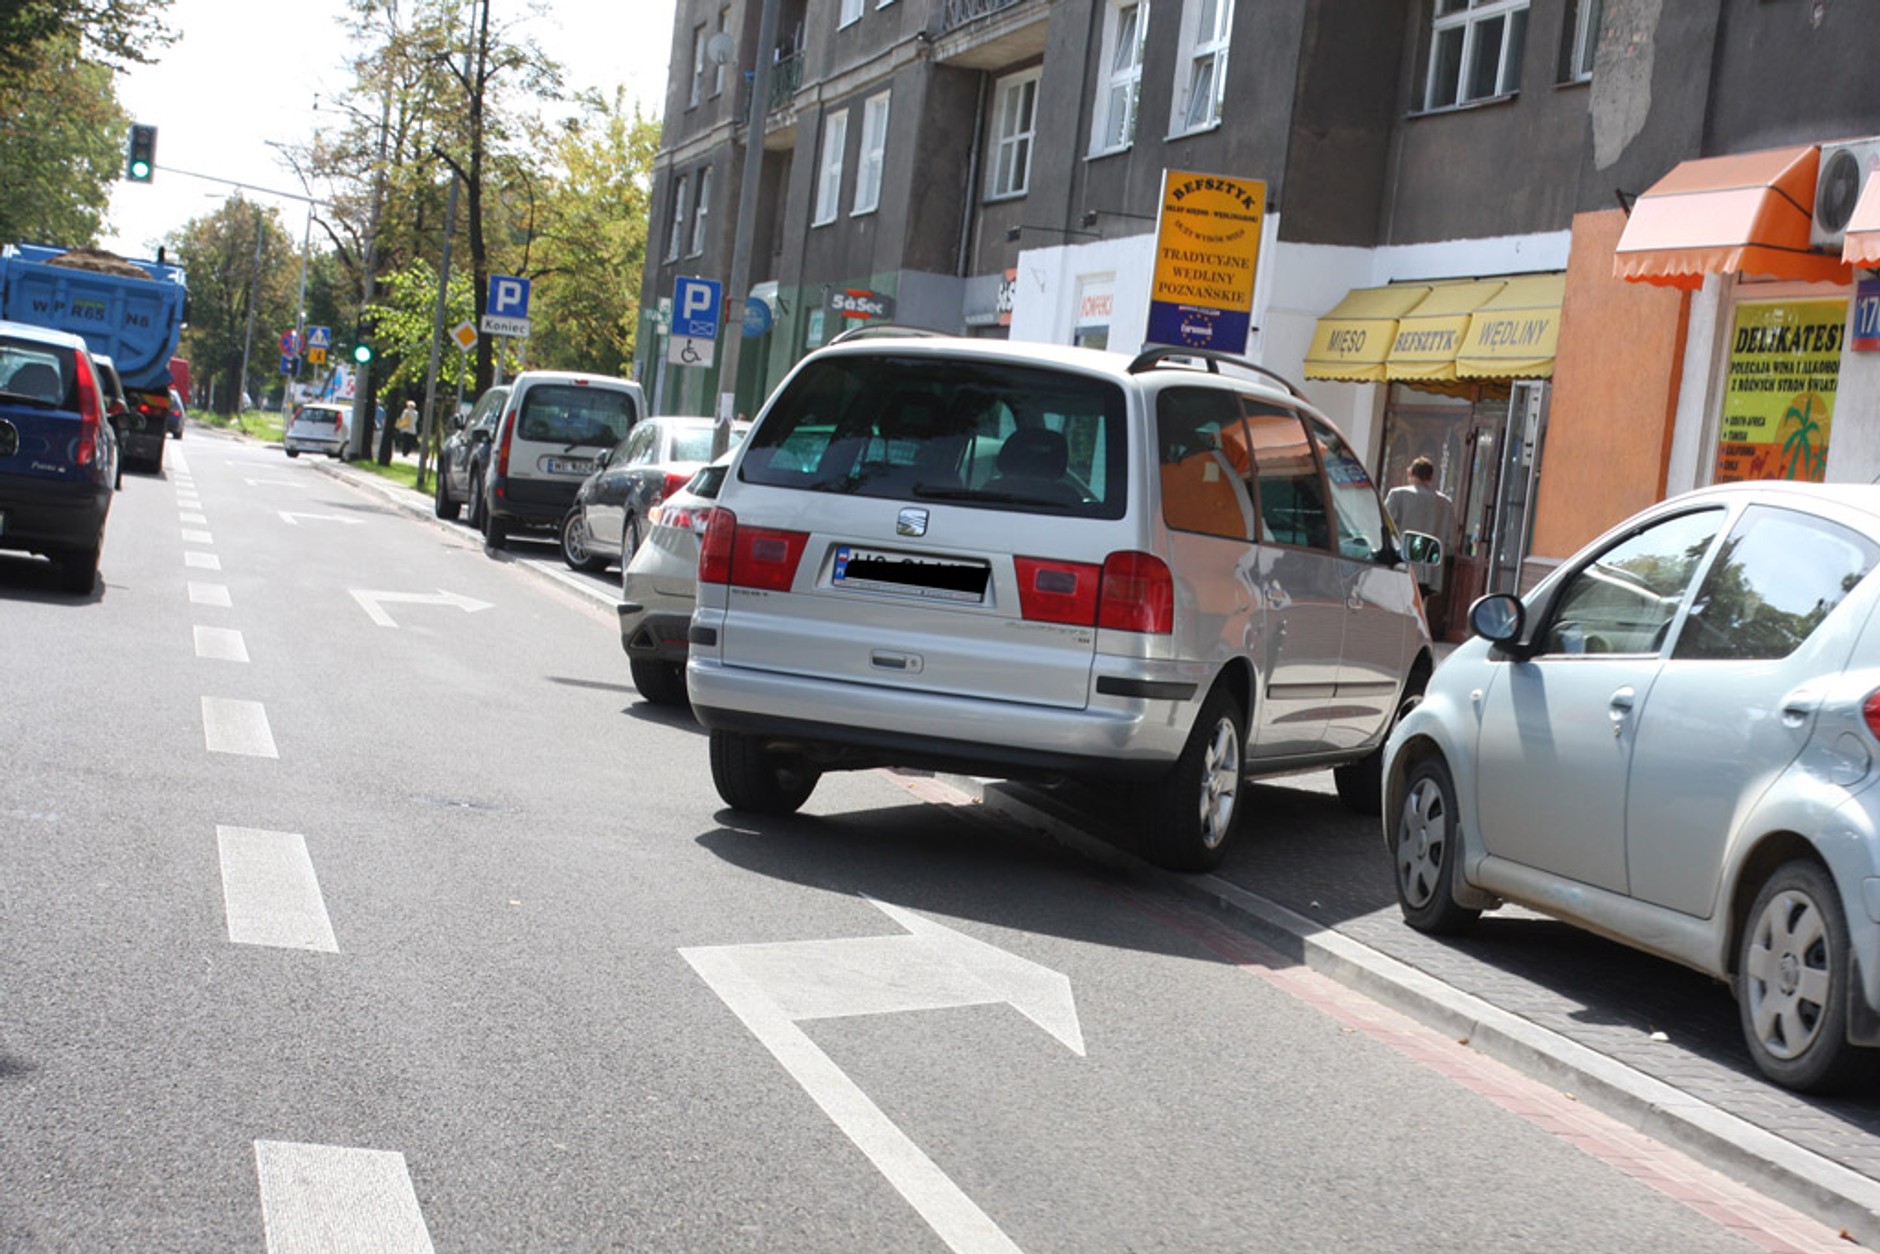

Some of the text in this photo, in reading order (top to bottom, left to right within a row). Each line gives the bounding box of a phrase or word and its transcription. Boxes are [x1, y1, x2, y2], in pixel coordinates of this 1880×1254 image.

[1173, 178, 1255, 210] BEFSZTYK
[1162, 247, 1250, 269] TRADYCYJNE
[1173, 266, 1235, 285] WĘDLINY
[496, 280, 522, 312] P
[683, 283, 711, 319] P
[1158, 281, 1245, 303] POZNAŃSKIE
[485, 319, 526, 333] Koniec
[1478, 319, 1549, 354] WĘDLINY
[1327, 330, 1367, 357] MIĘSO
[1393, 329, 1456, 354] BEFSZTYK
